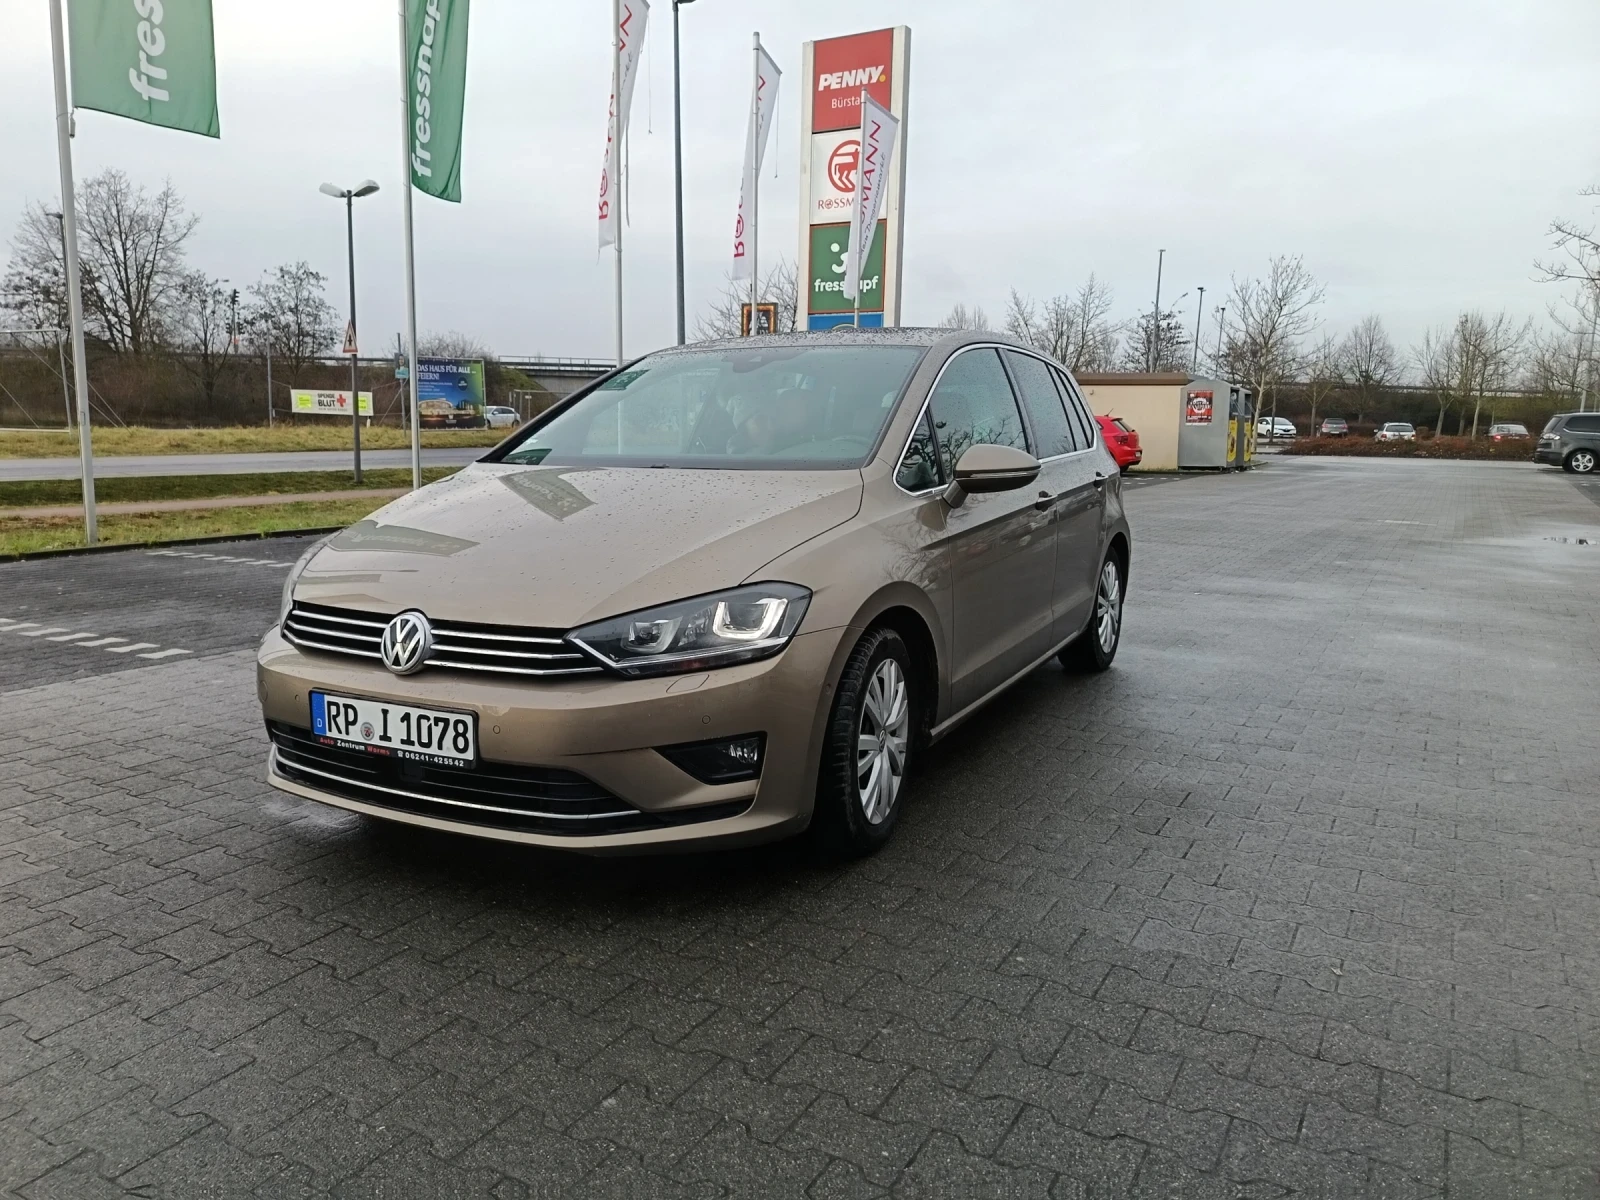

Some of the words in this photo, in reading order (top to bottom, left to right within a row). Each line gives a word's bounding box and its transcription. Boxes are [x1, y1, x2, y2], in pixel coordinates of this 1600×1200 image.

[411, 0, 441, 178] fressnap
[831, 96, 860, 109] Bürsta
[818, 197, 855, 210] ROSSM
[814, 275, 879, 293] fresspf
[429, 365, 445, 373] HAUS
[446, 364, 457, 374] FÜR
[458, 366, 470, 374] ALLE
[318, 399, 335, 407] BLUT
[327, 700, 358, 736] RP
[400, 712, 469, 754] 1078
[319, 737, 334, 745] Auto
[337, 740, 365, 751] Zentrum
[367, 745, 390, 755] Worms
